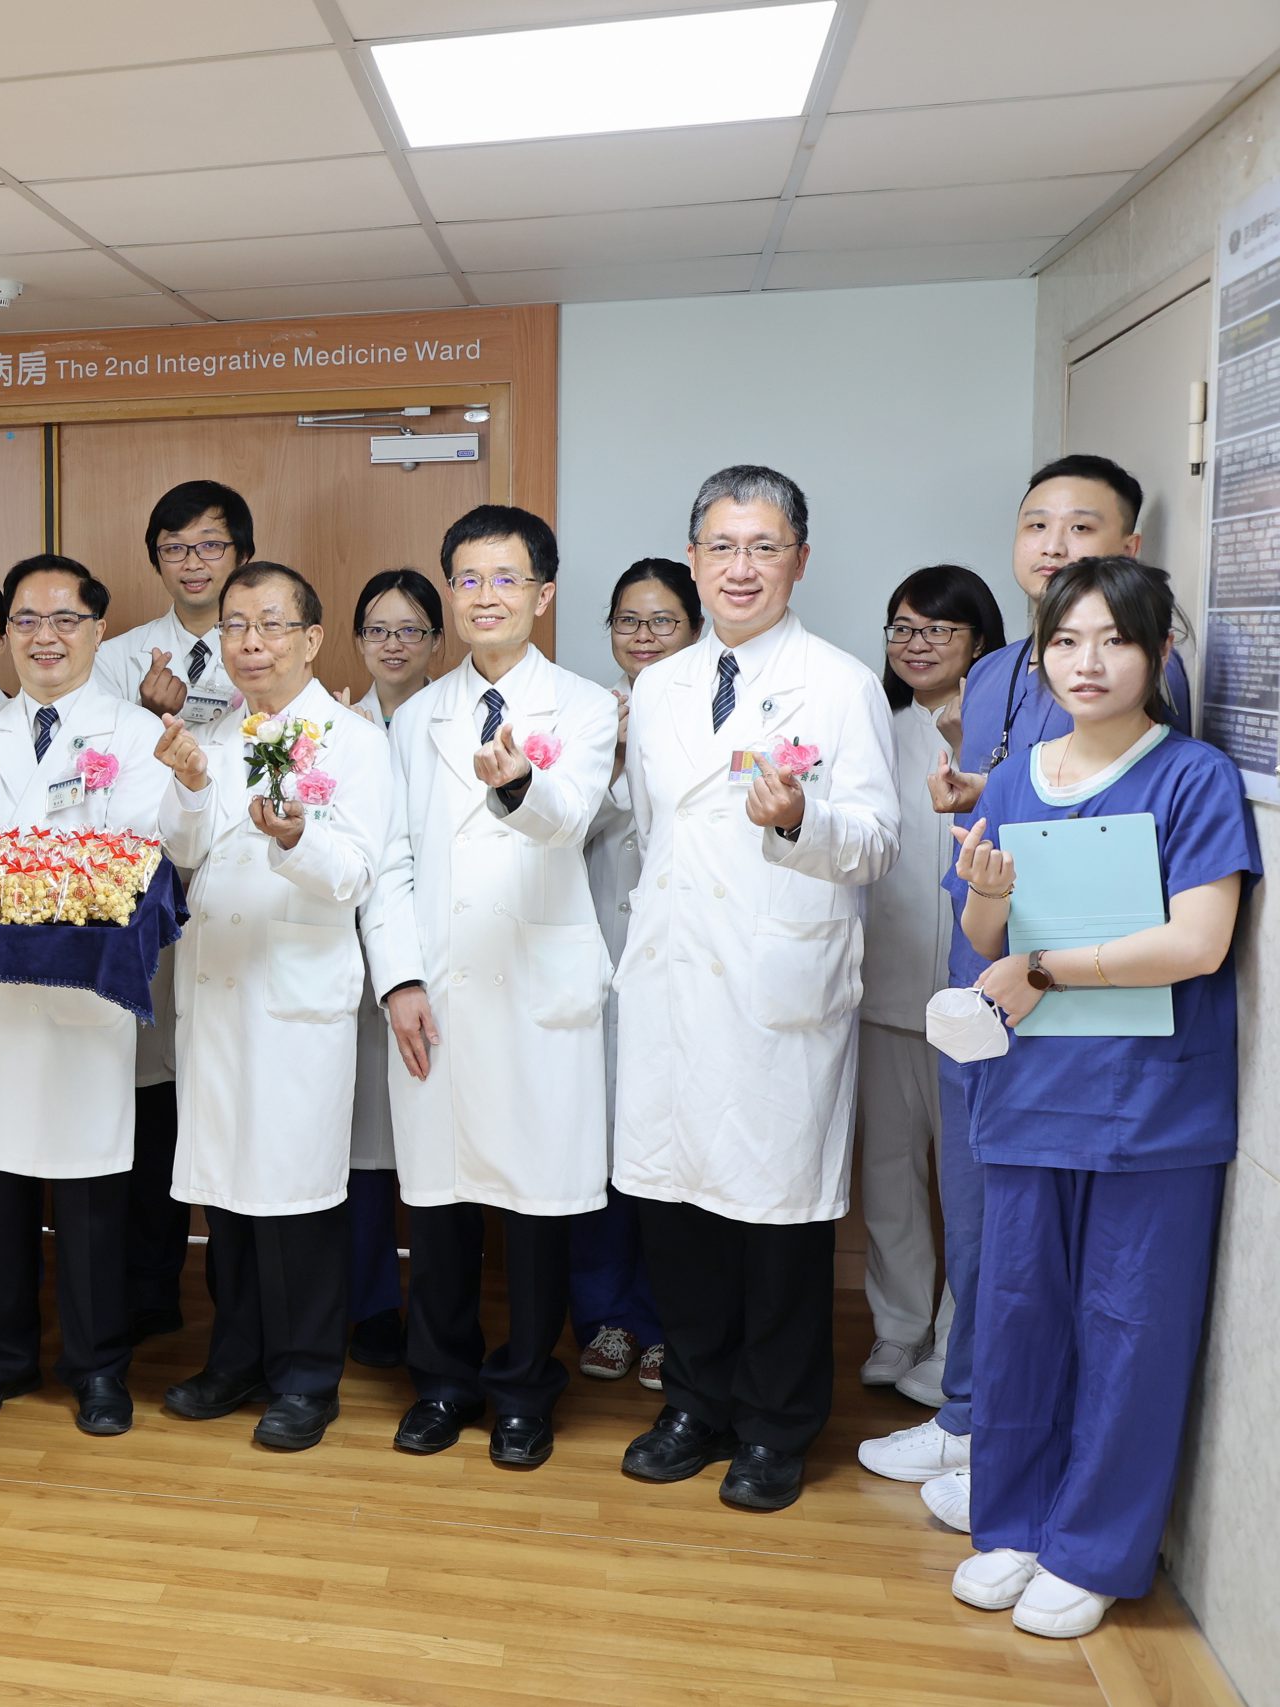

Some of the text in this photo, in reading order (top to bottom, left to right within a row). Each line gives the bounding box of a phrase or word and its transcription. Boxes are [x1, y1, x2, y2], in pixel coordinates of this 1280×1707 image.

[55, 338, 481, 380] The 2nd Integrative Medicine Ward
